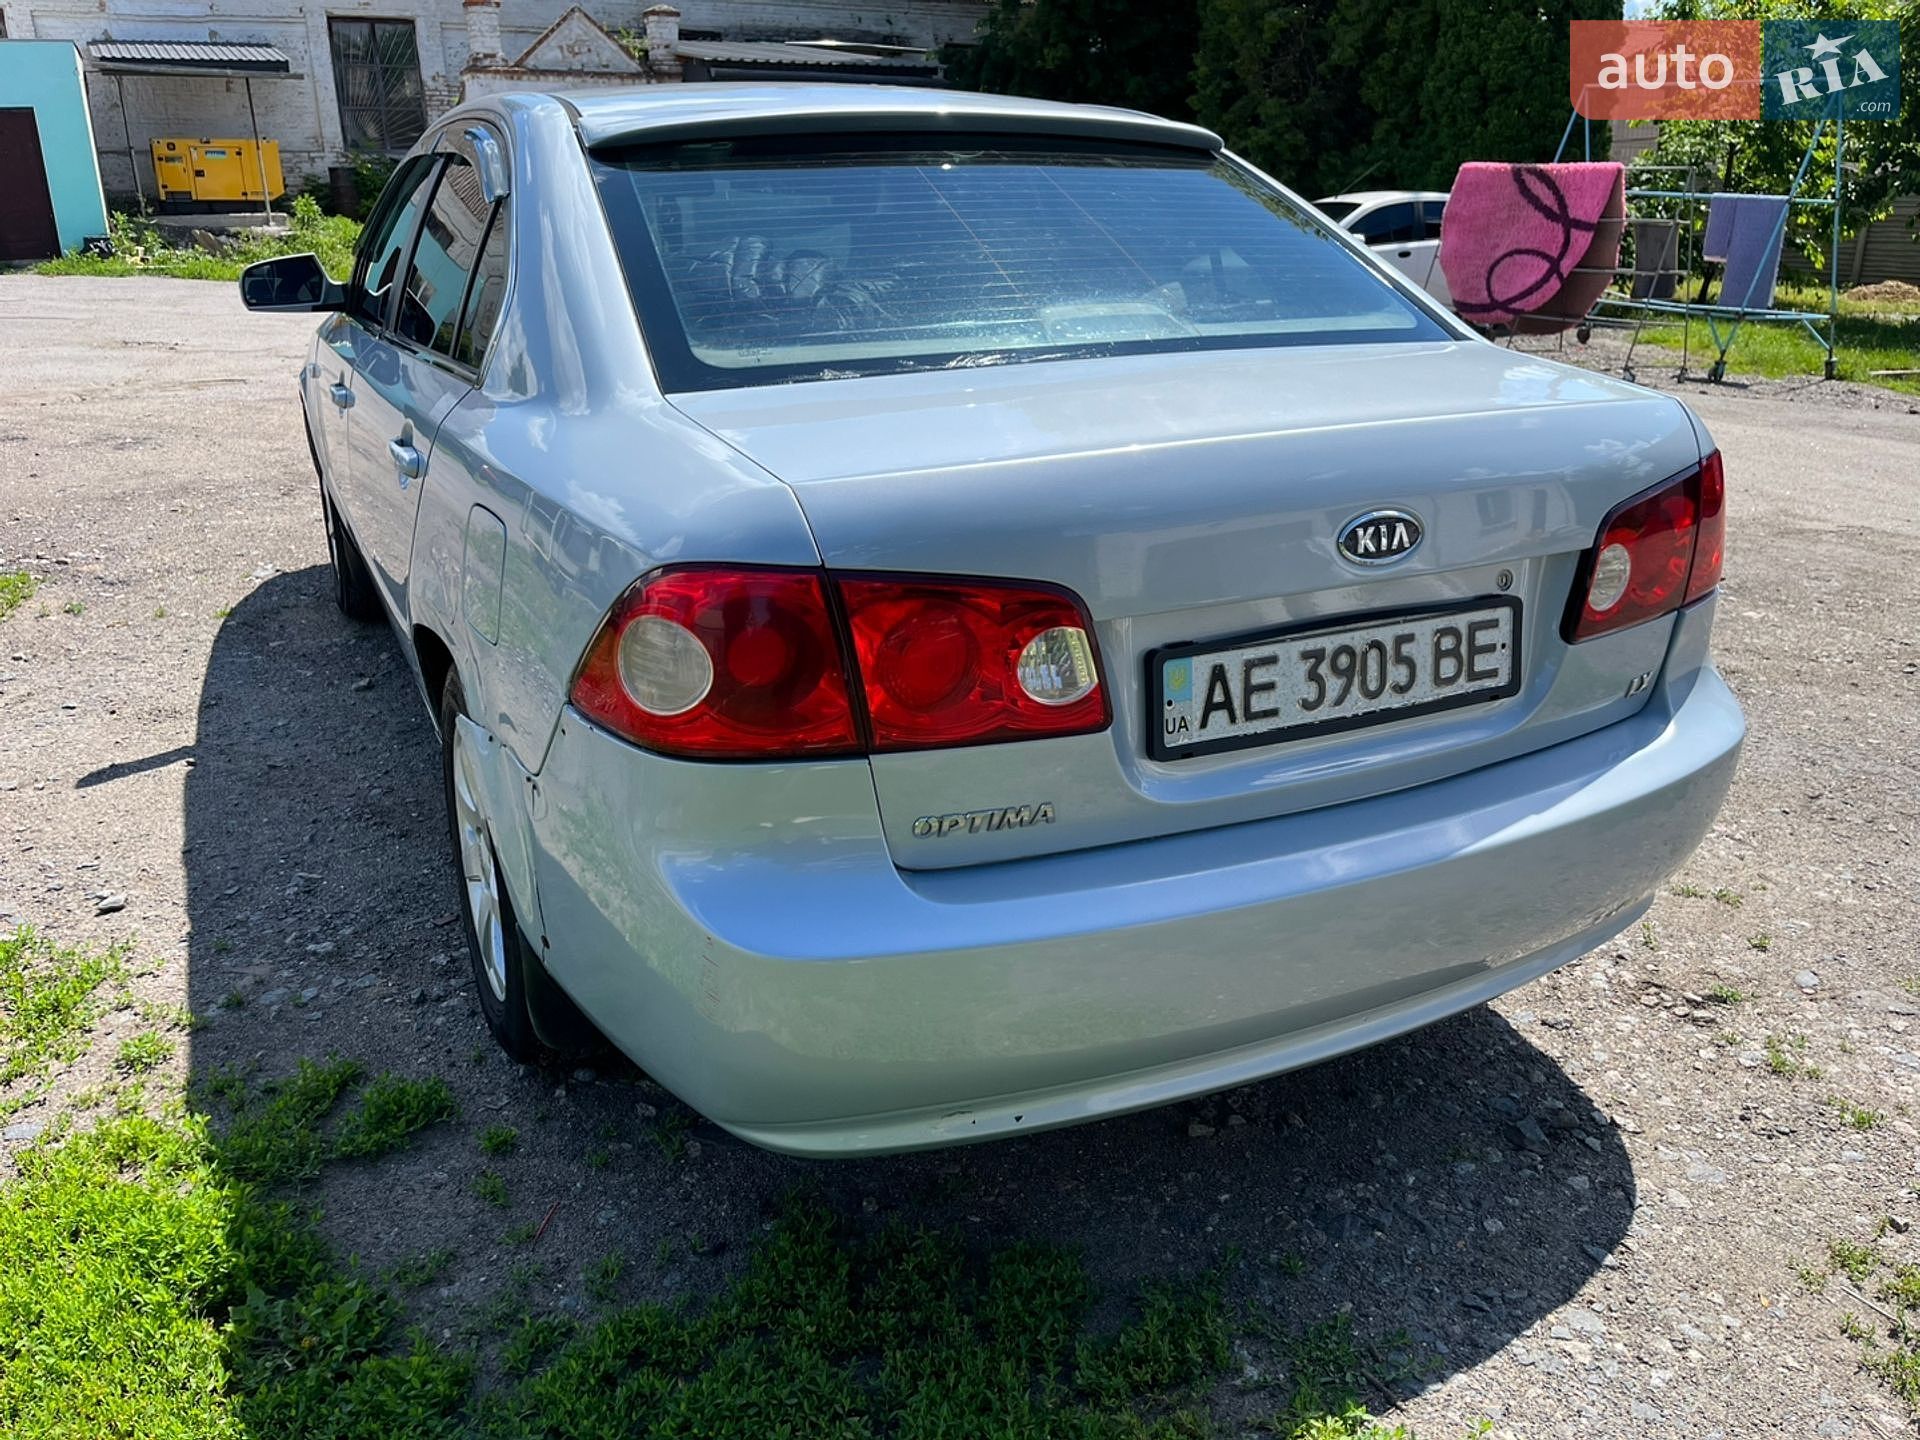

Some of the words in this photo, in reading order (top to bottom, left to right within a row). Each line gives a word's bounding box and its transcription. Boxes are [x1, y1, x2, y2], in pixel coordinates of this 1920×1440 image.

[1355, 522, 1411, 554] KIA
[1200, 655, 1279, 729] AE
[1299, 633, 1416, 711] 3905
[1433, 618, 1499, 687] BE
[1165, 716, 1189, 735] UA
[912, 802, 1056, 839] OPTIMA
